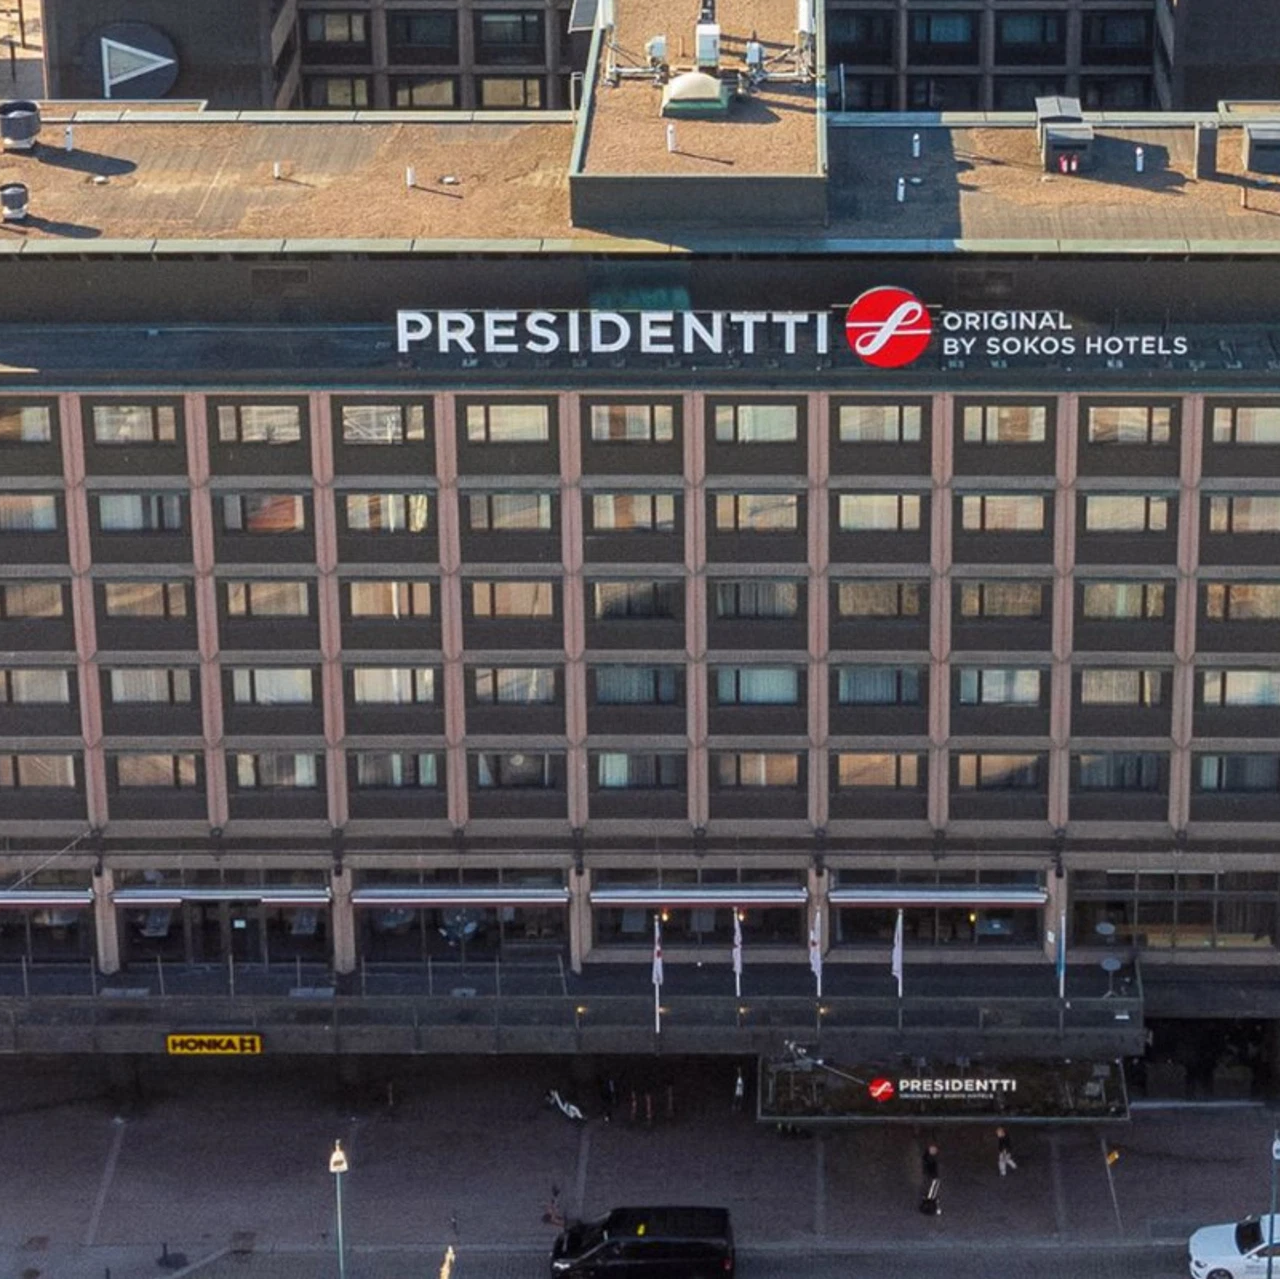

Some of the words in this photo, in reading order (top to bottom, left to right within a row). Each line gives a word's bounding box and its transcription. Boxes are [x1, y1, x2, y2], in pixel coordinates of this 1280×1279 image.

[943, 311, 1073, 332] ORIGINAL
[396, 310, 829, 354] PRESIDENTTI
[943, 337, 977, 355] BY
[986, 336, 1076, 355] SOKOS
[1085, 336, 1188, 355] HOTELS
[171, 1038, 238, 1052] HONKA
[899, 1079, 1017, 1092] PRESIDENTTI
